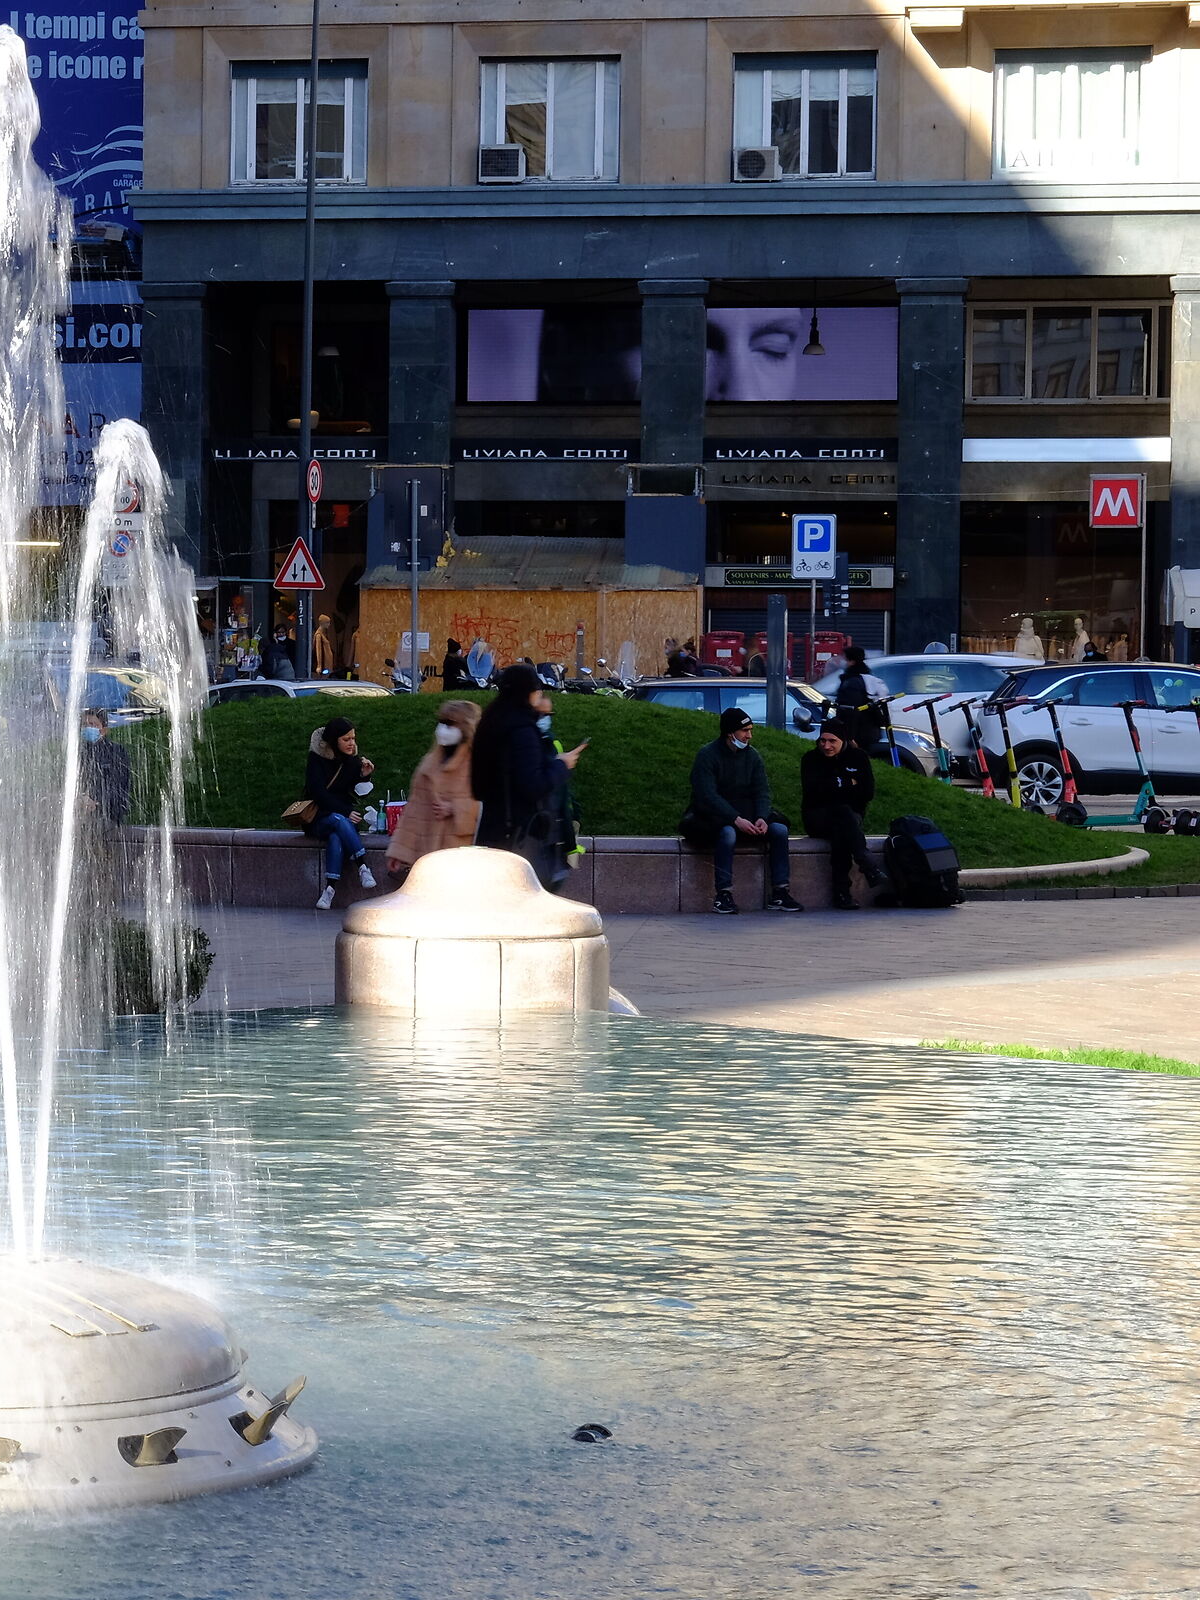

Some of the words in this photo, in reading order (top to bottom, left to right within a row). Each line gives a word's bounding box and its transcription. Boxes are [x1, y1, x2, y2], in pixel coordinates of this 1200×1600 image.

[25, 11, 105, 42] tempi
[48, 50, 127, 79] icone
[113, 179, 143, 188] GARAGE
[463, 449, 548, 458] LIVIANA
[563, 449, 628, 458] CONTI
[716, 449, 802, 458] LIVIANA
[818, 449, 885, 458] CONTI
[311, 471, 319, 490] 30
[1093, 487, 1136, 517] M
[803, 523, 825, 549] P
